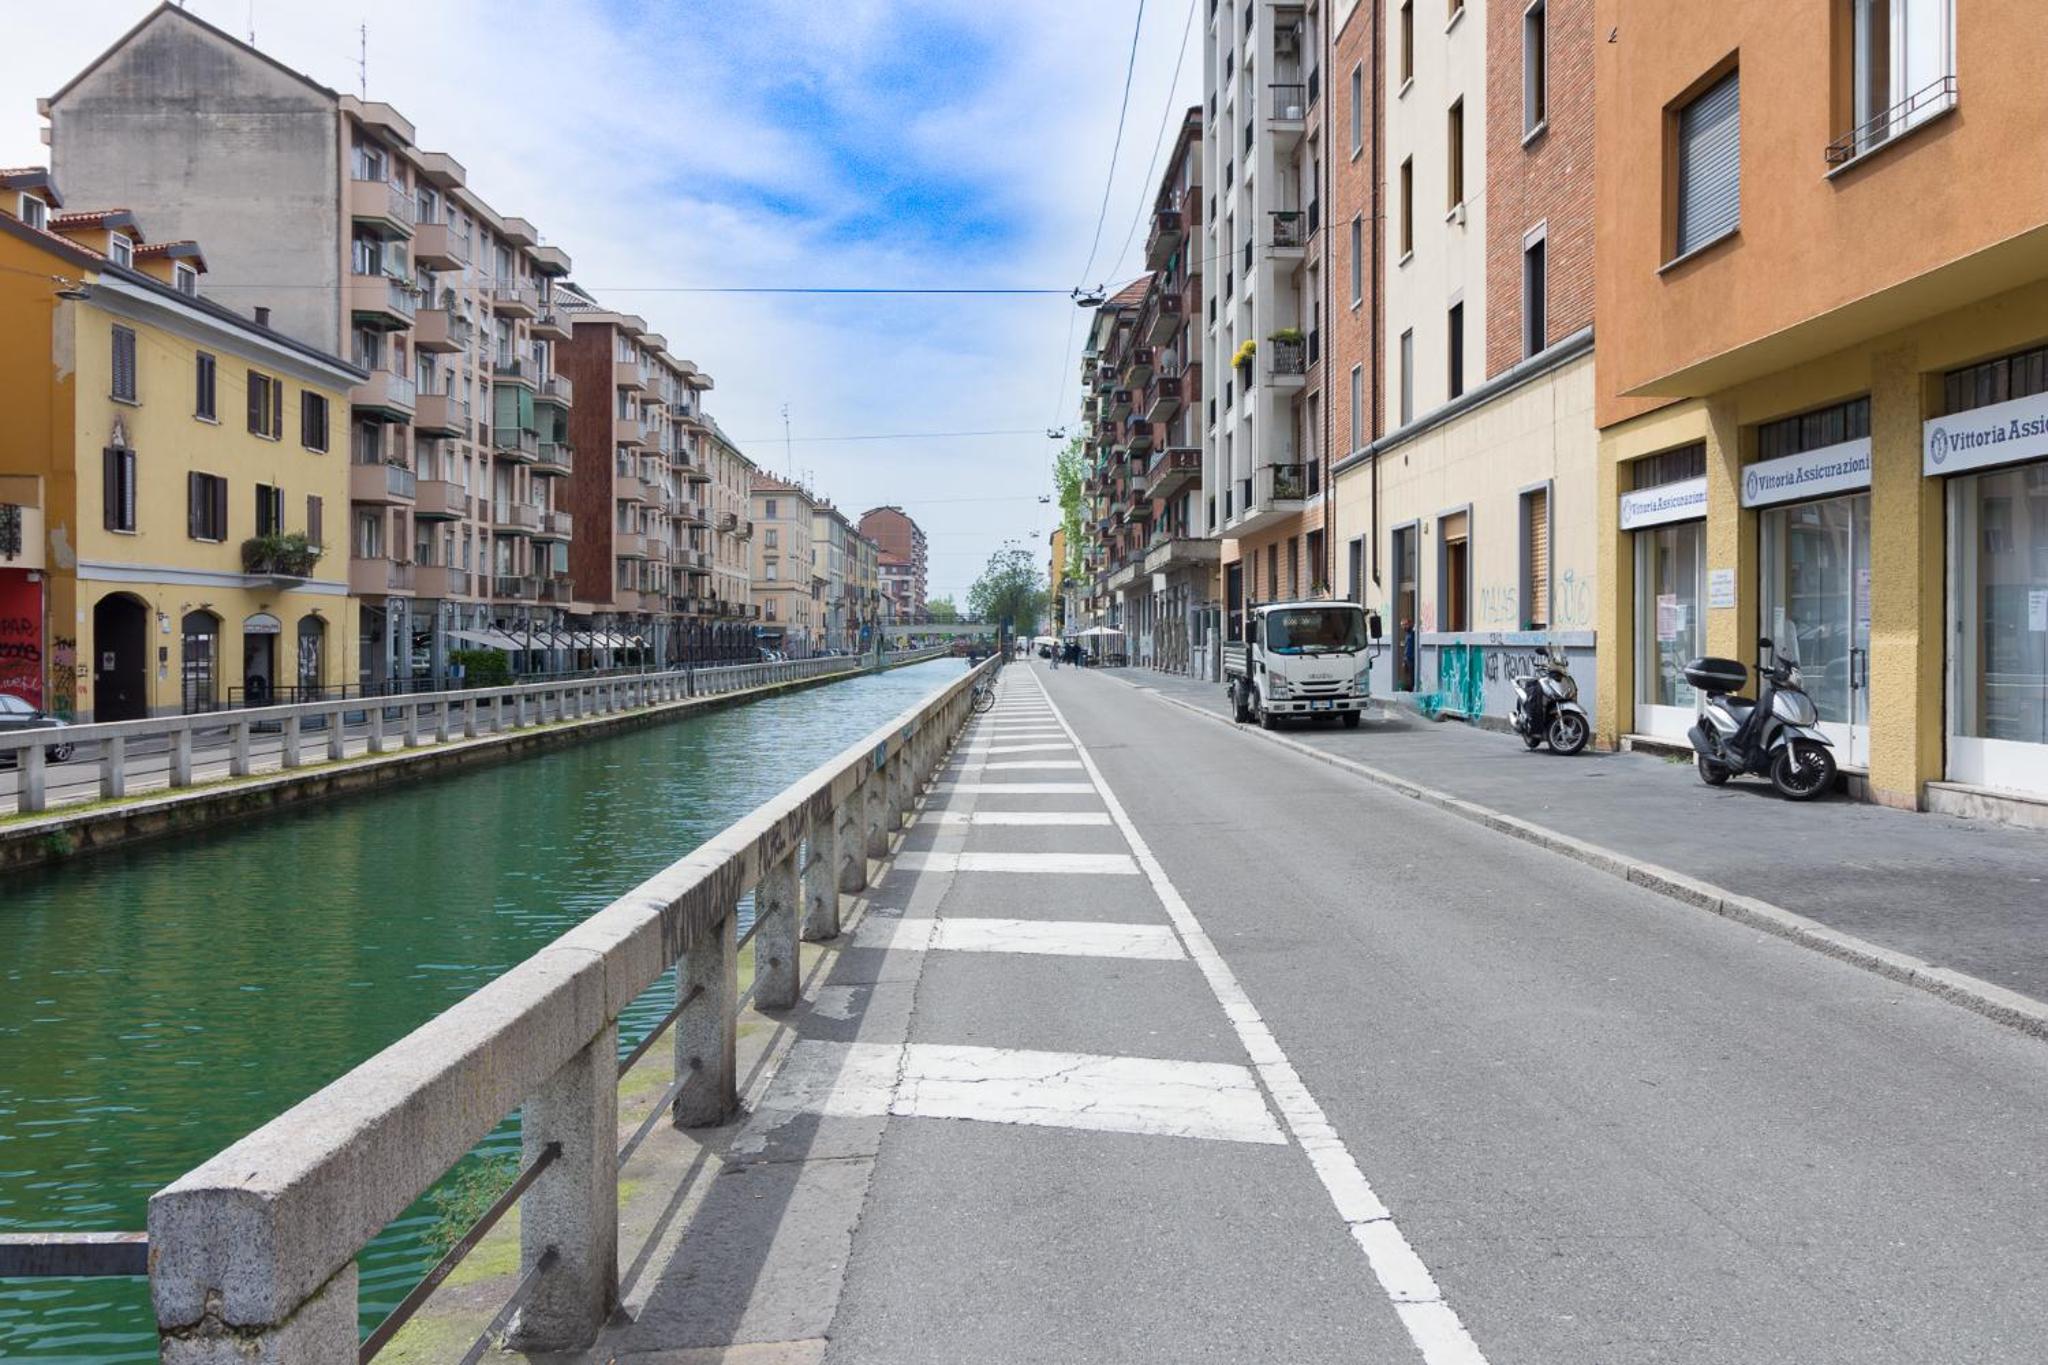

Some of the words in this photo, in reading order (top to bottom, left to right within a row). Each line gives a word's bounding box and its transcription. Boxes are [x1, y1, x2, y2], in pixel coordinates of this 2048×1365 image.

[1949, 425, 2006, 452] Vittoria
[1758, 471, 1794, 491] Vittoria
[1795, 453, 1870, 484] Assicurazioni
